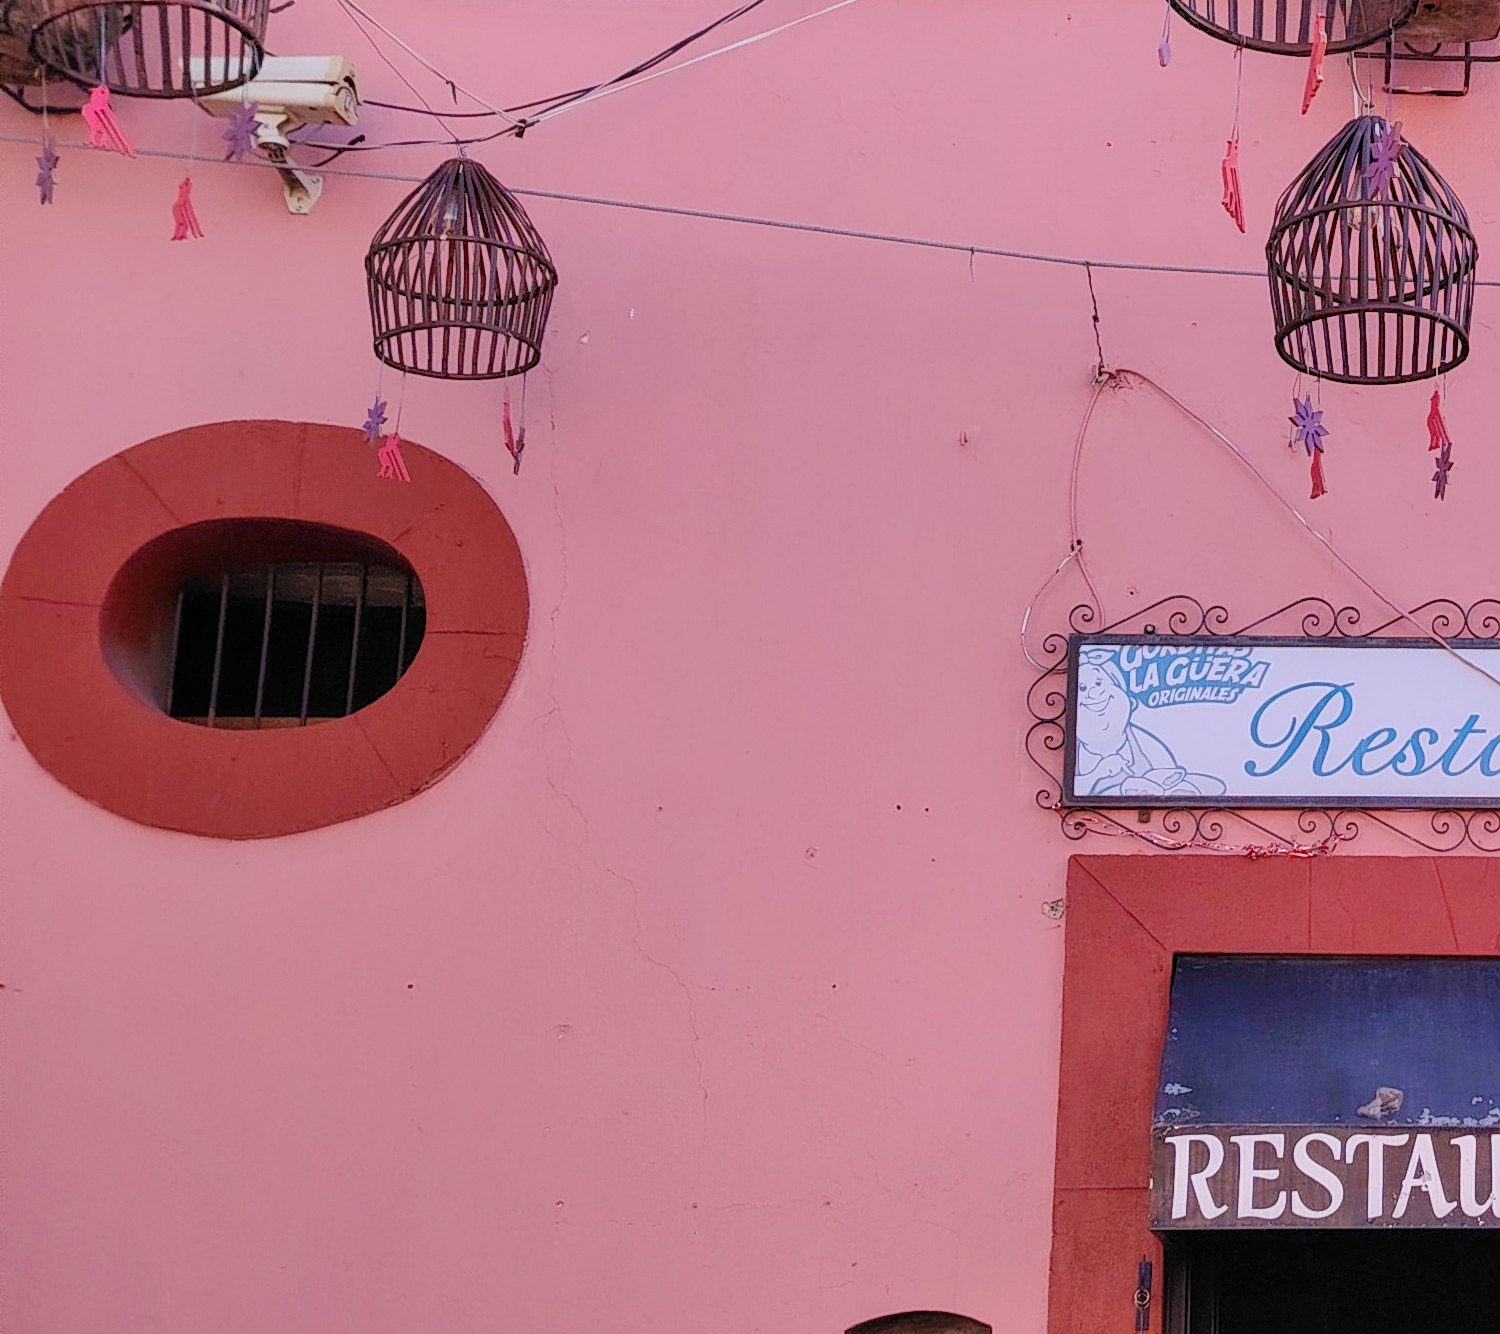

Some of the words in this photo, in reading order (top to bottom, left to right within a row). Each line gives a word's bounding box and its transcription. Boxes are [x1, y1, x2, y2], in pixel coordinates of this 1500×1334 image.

[1129, 661, 1160, 693] LA
[1165, 656, 1268, 686] GÜERA
[1148, 687, 1240, 707] ORIGINALES
